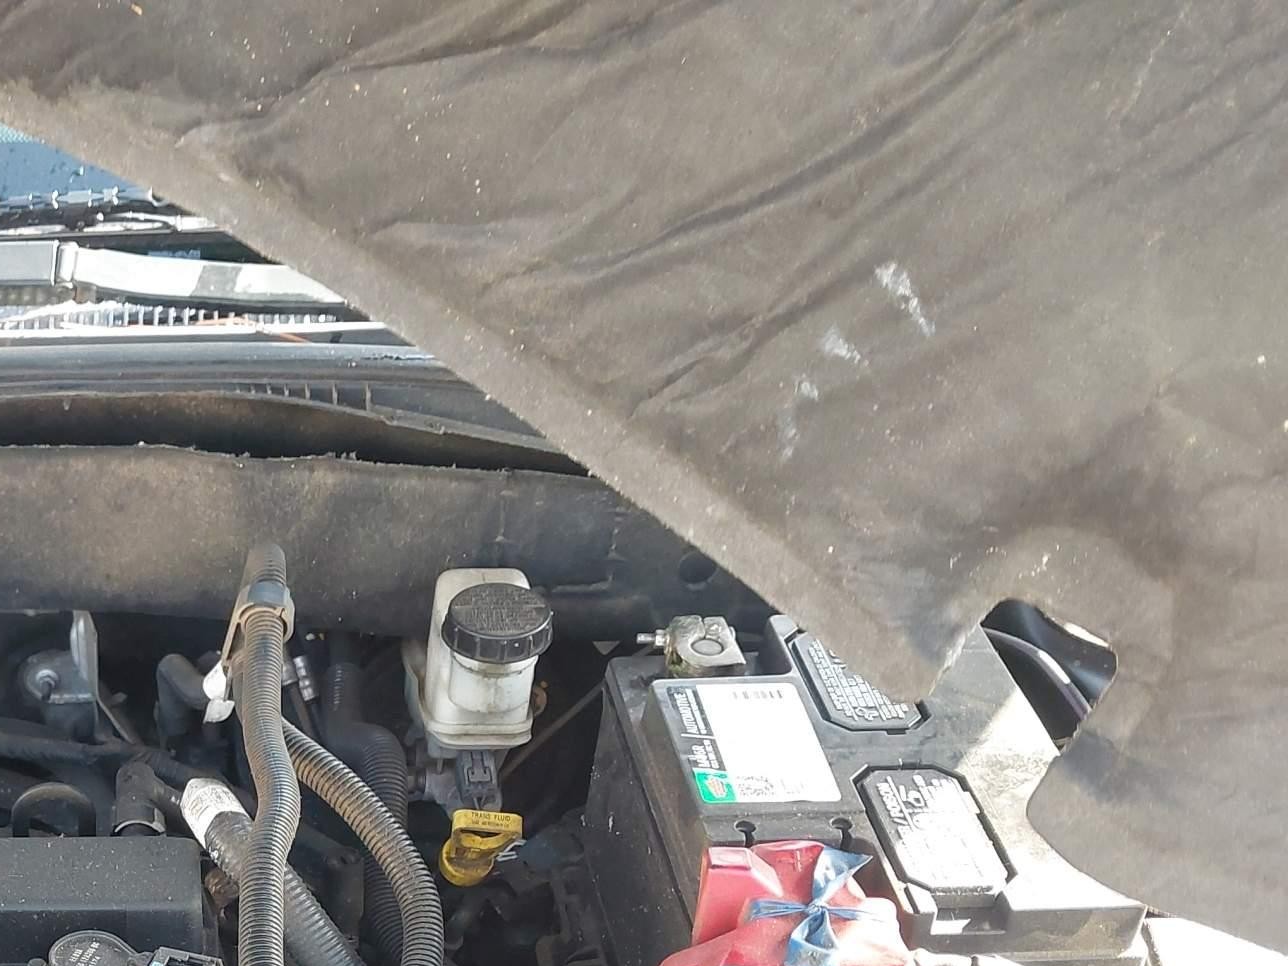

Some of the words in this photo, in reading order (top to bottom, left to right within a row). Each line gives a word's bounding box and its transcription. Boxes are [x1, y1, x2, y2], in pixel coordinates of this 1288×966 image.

[673, 692, 700, 735] AUTOMOTIVE
[472, 811, 491, 820] TRANS
[494, 814, 511, 822] FLUID
